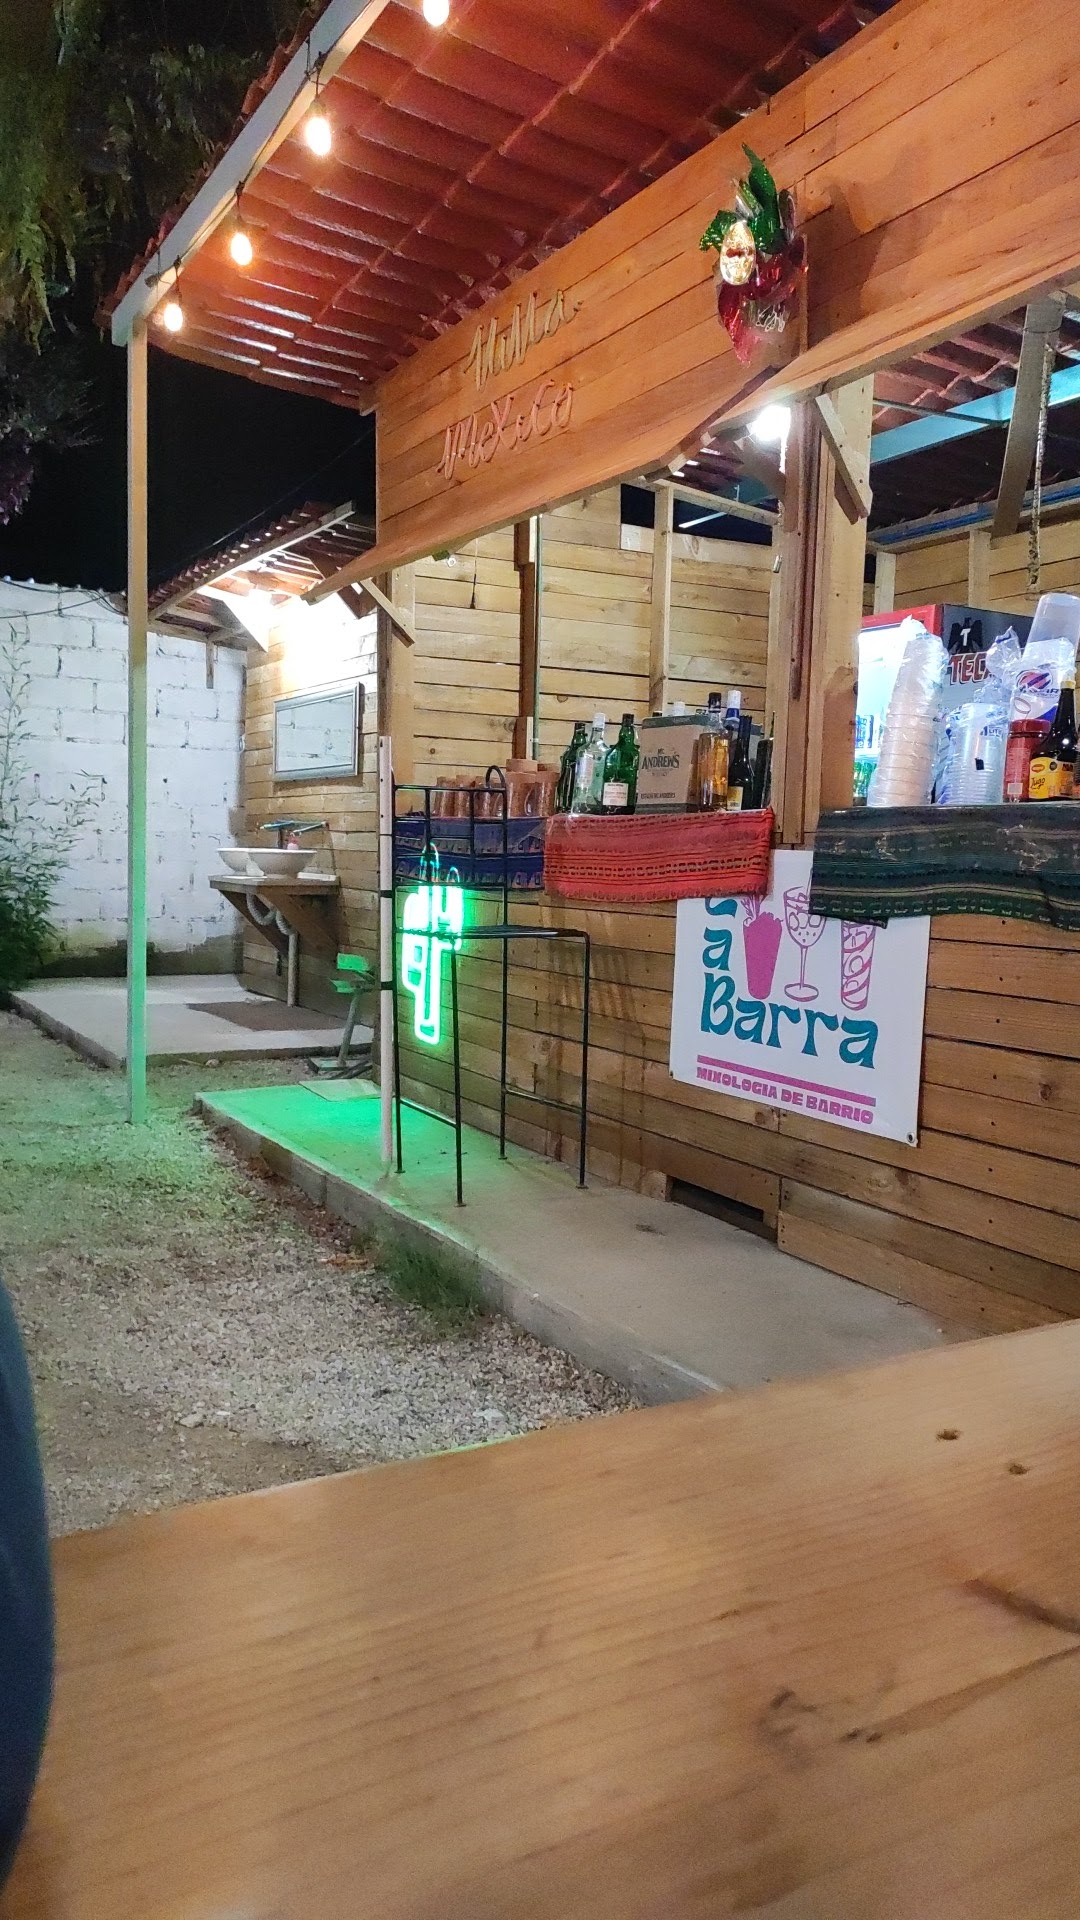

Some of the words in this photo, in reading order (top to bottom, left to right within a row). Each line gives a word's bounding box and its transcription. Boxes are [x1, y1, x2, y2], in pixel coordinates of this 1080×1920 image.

[948, 650, 990, 685] TEC
[700, 972, 880, 1069] Barra
[696, 1066, 777, 1100] MIXOLOGIA
[780, 1088, 804, 1107] DE
[805, 1095, 874, 1125] BARRIO
